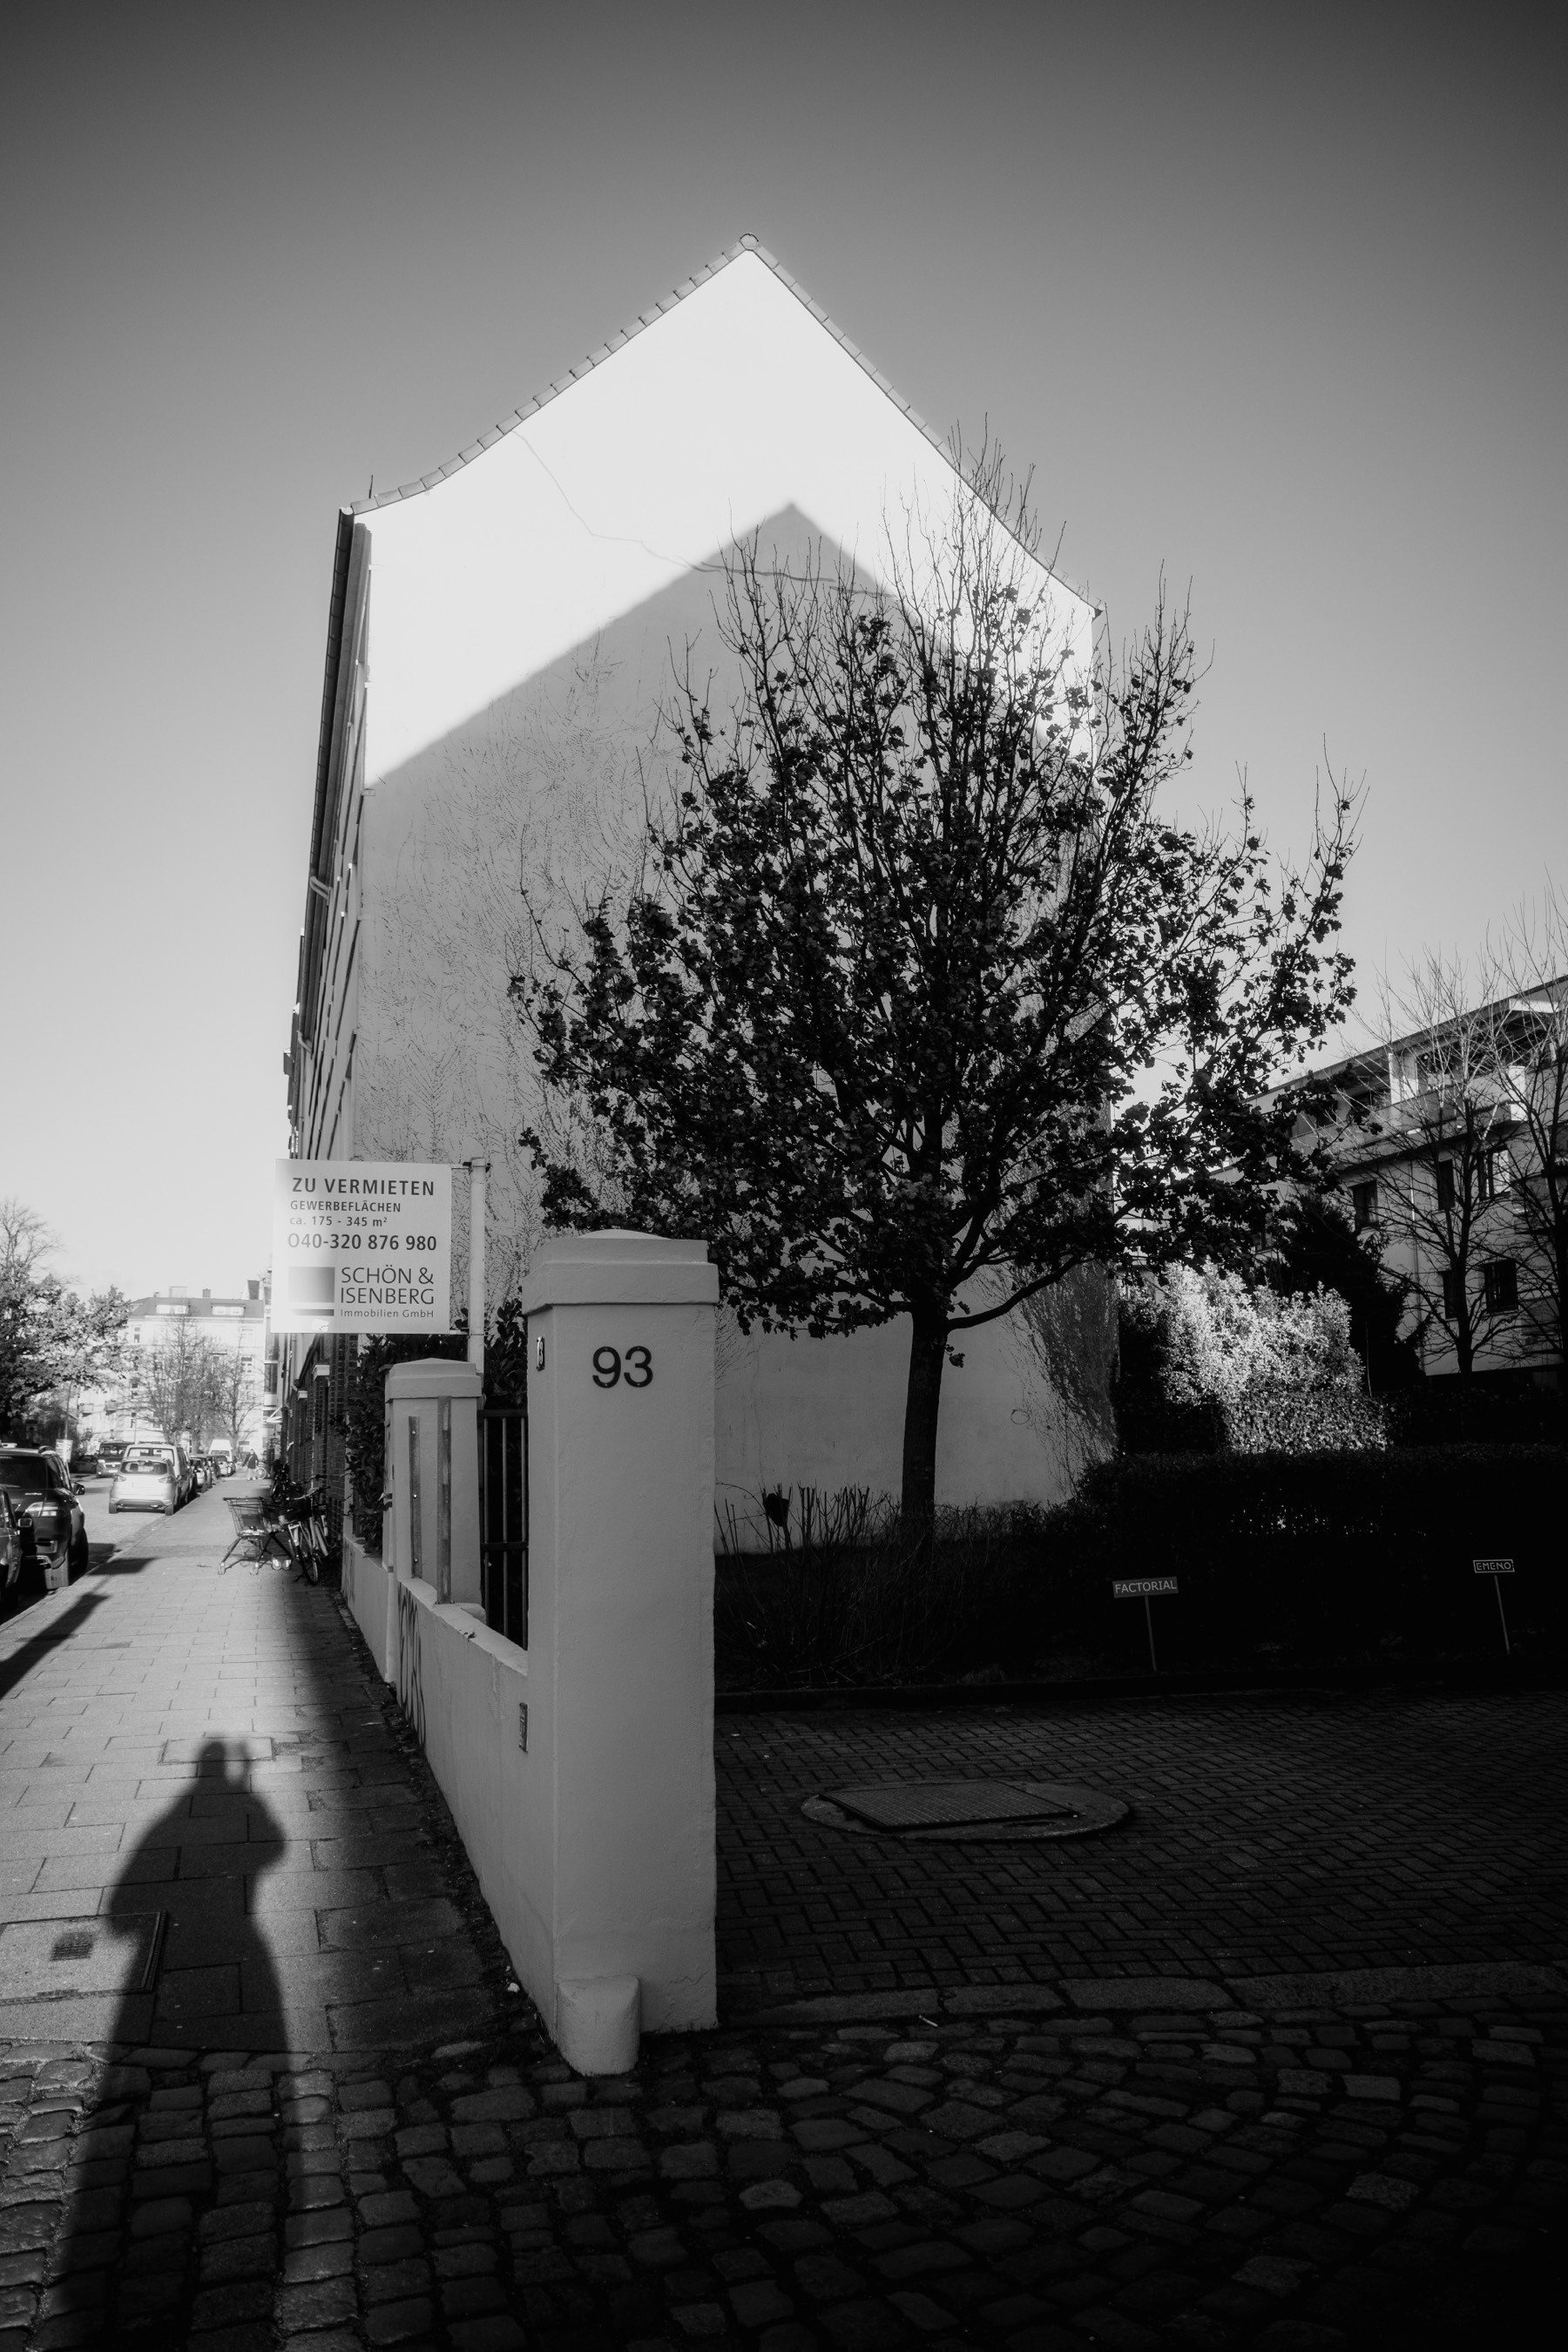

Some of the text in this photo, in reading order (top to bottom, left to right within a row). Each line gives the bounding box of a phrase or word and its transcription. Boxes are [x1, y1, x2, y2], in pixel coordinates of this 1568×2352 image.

[292, 1177, 434, 1196] ZU VERMIETEN
[290, 1200, 401, 1213] GEWERBEFLÄCHEN
[289, 1217, 307, 1226] ca.
[311, 1215, 333, 1226] 175
[346, 1216, 368, 1227] 345
[368, 1234, 399, 1250] 876
[406, 1235, 437, 1251] 980
[341, 1264, 434, 1285] SCHÖN &
[341, 1288, 434, 1305] ISENBERG
[341, 1309, 434, 1318] Immobilien GmbH
[592, 1346, 653, 1389] 93
[1476, 1562, 1511, 1571] EMENO
[1115, 1580, 1177, 1593] FACTORIAL
